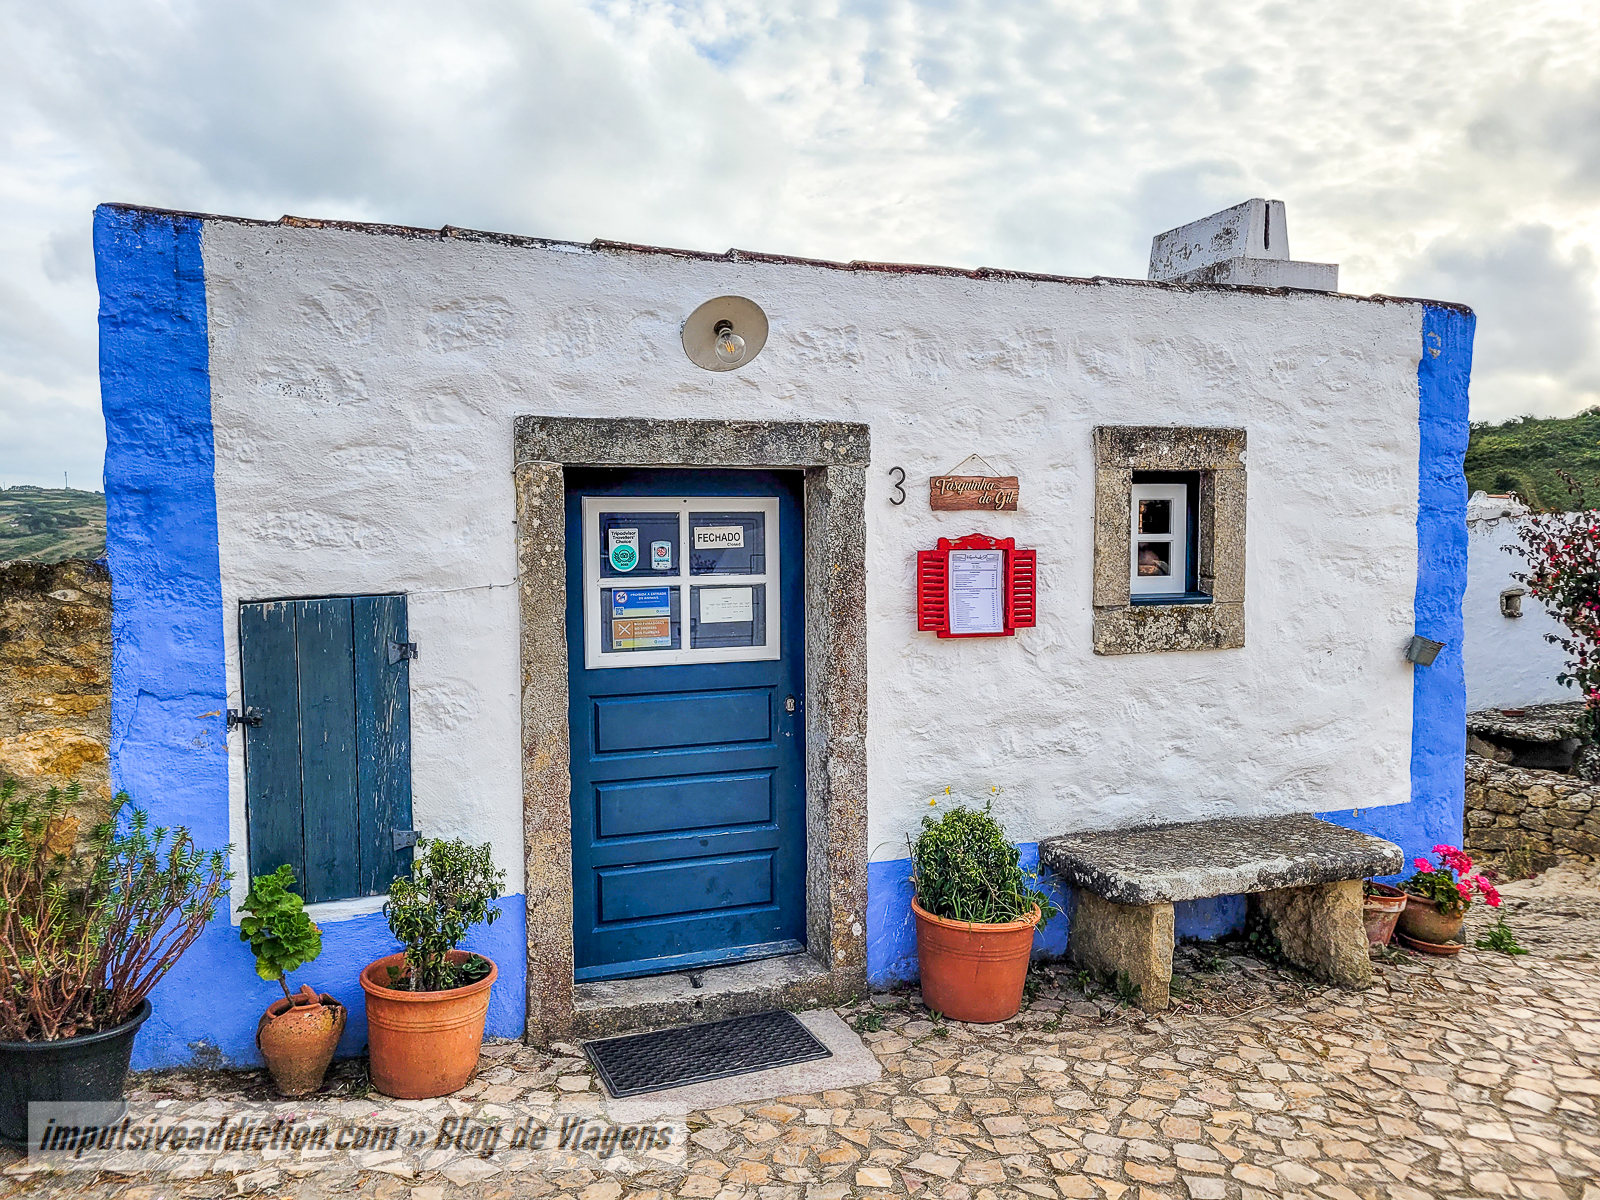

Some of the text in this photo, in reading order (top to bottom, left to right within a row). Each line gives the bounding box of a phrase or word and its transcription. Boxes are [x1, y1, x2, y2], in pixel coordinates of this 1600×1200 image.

[888, 466, 906, 506] 3
[935, 477, 995, 495] Tasquinha
[978, 490, 1015, 511] do Gil
[697, 532, 741, 543] FECHADO
